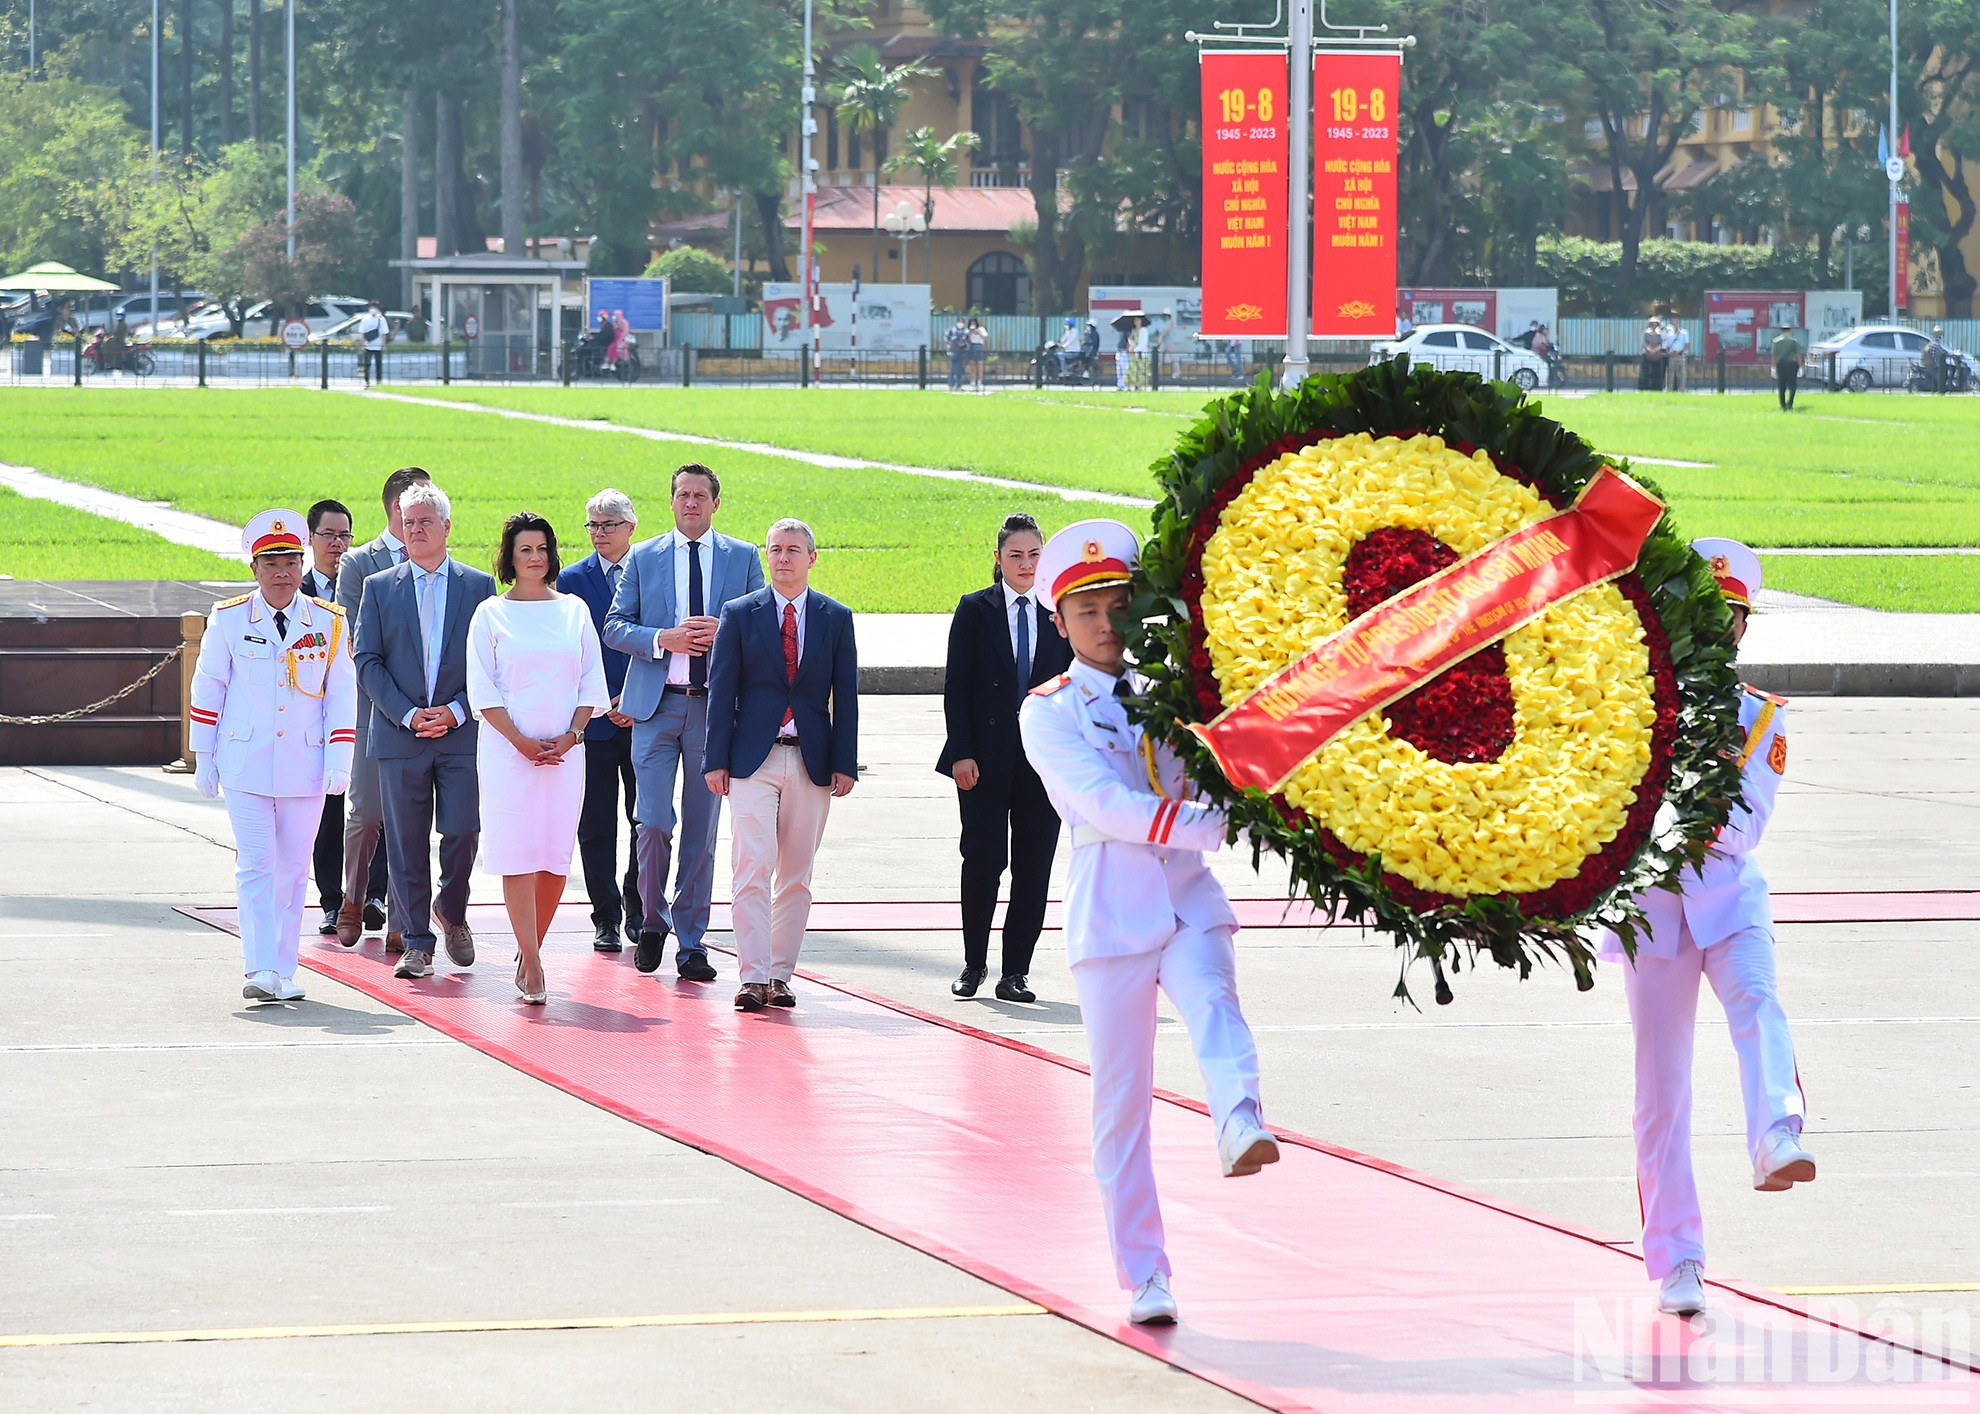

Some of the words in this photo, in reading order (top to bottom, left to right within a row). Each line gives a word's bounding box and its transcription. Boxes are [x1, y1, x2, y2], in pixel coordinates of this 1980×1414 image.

[1216, 128, 1240, 140] 1945
[1249, 127, 1276, 139] 2023
[1327, 127, 1352, 139] 1945
[1362, 127, 1389, 139] 2023
[1244, 178, 1259, 195] HỘI
[1357, 177, 1372, 194] HỘI
[1227, 215, 1243, 232] VIỆT
[1244, 216, 1264, 229] NAM
[1338, 213, 1356, 231] VIỆT
[1357, 216, 1377, 229] NAM
[1256, 655, 1348, 722] HOMAGE
[1338, 637, 1371, 669] TO
[1358, 587, 1464, 655] PRESIDENT
[1509, 529, 1571, 571] MINH
